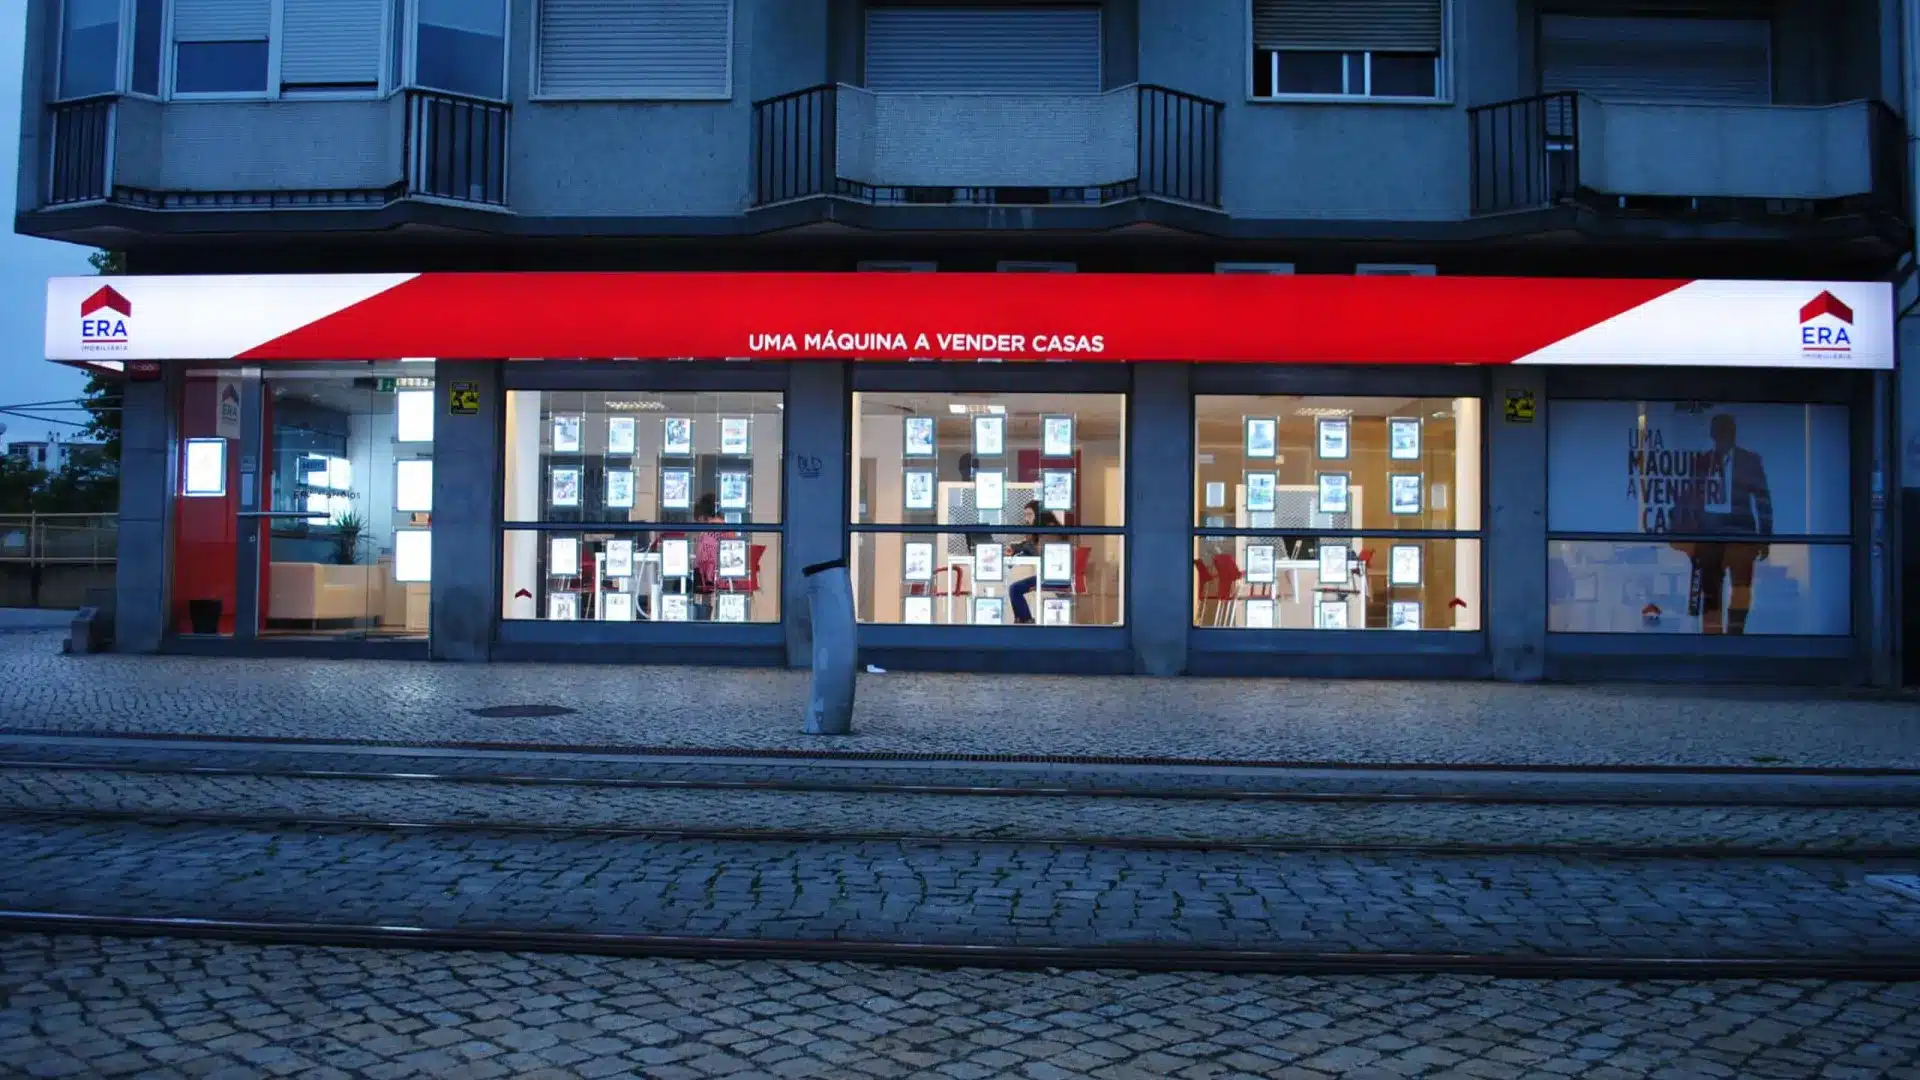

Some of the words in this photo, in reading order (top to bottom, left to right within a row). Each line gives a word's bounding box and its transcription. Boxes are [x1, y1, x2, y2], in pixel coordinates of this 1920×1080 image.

[82, 319, 128, 337] ERA
[1802, 326, 1851, 345] ERA
[748, 333, 798, 351] UMA
[804, 329, 908, 351] MÁQUINA
[913, 333, 931, 350] A
[936, 333, 1026, 352] VENDER
[1032, 335, 1105, 353] CASAS
[1628, 427, 1664, 450] UMA
[1626, 478, 1637, 500] A
